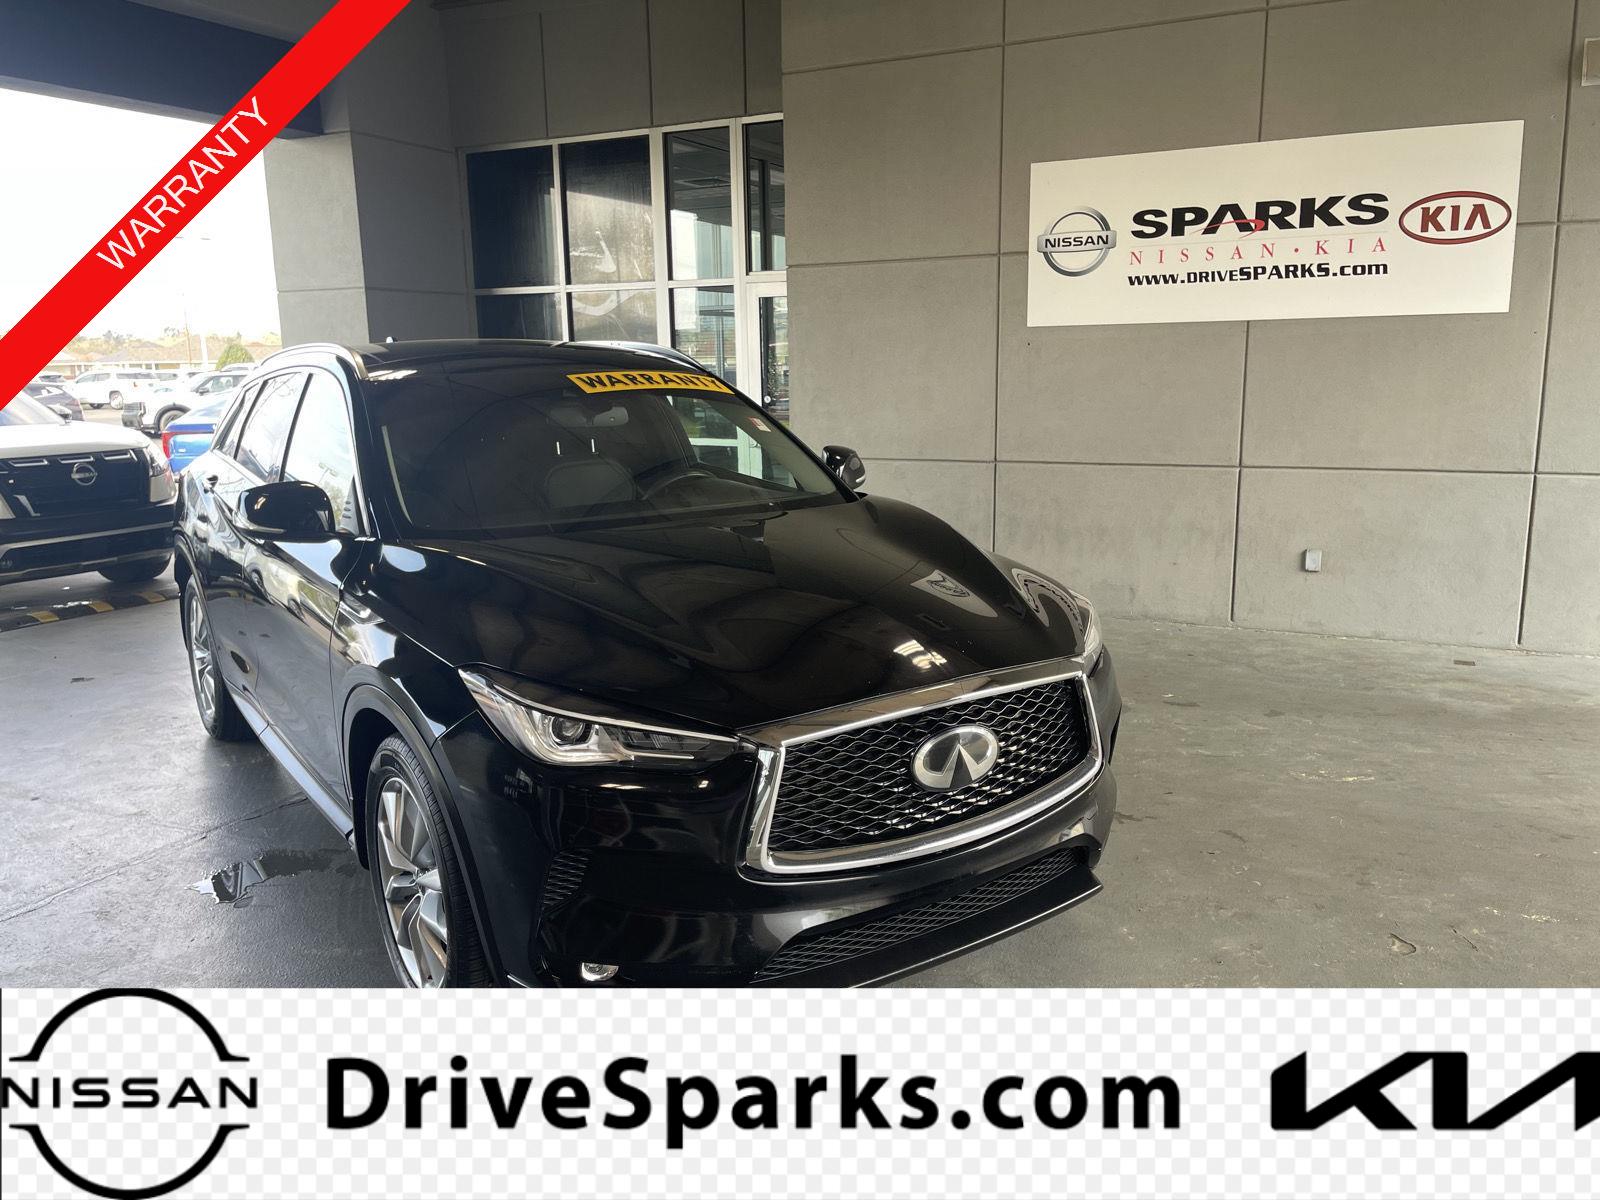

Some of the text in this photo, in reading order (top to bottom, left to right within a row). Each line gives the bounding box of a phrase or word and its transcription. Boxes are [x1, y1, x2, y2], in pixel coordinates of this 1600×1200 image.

[1131, 193, 1390, 239] SPARKS
[1419, 202, 1494, 233] KIA
[1044, 233, 1110, 249] NISSAN
[1129, 236, 1387, 266] NISSAN KIA
[576, 373, 724, 390] WARRANTY
